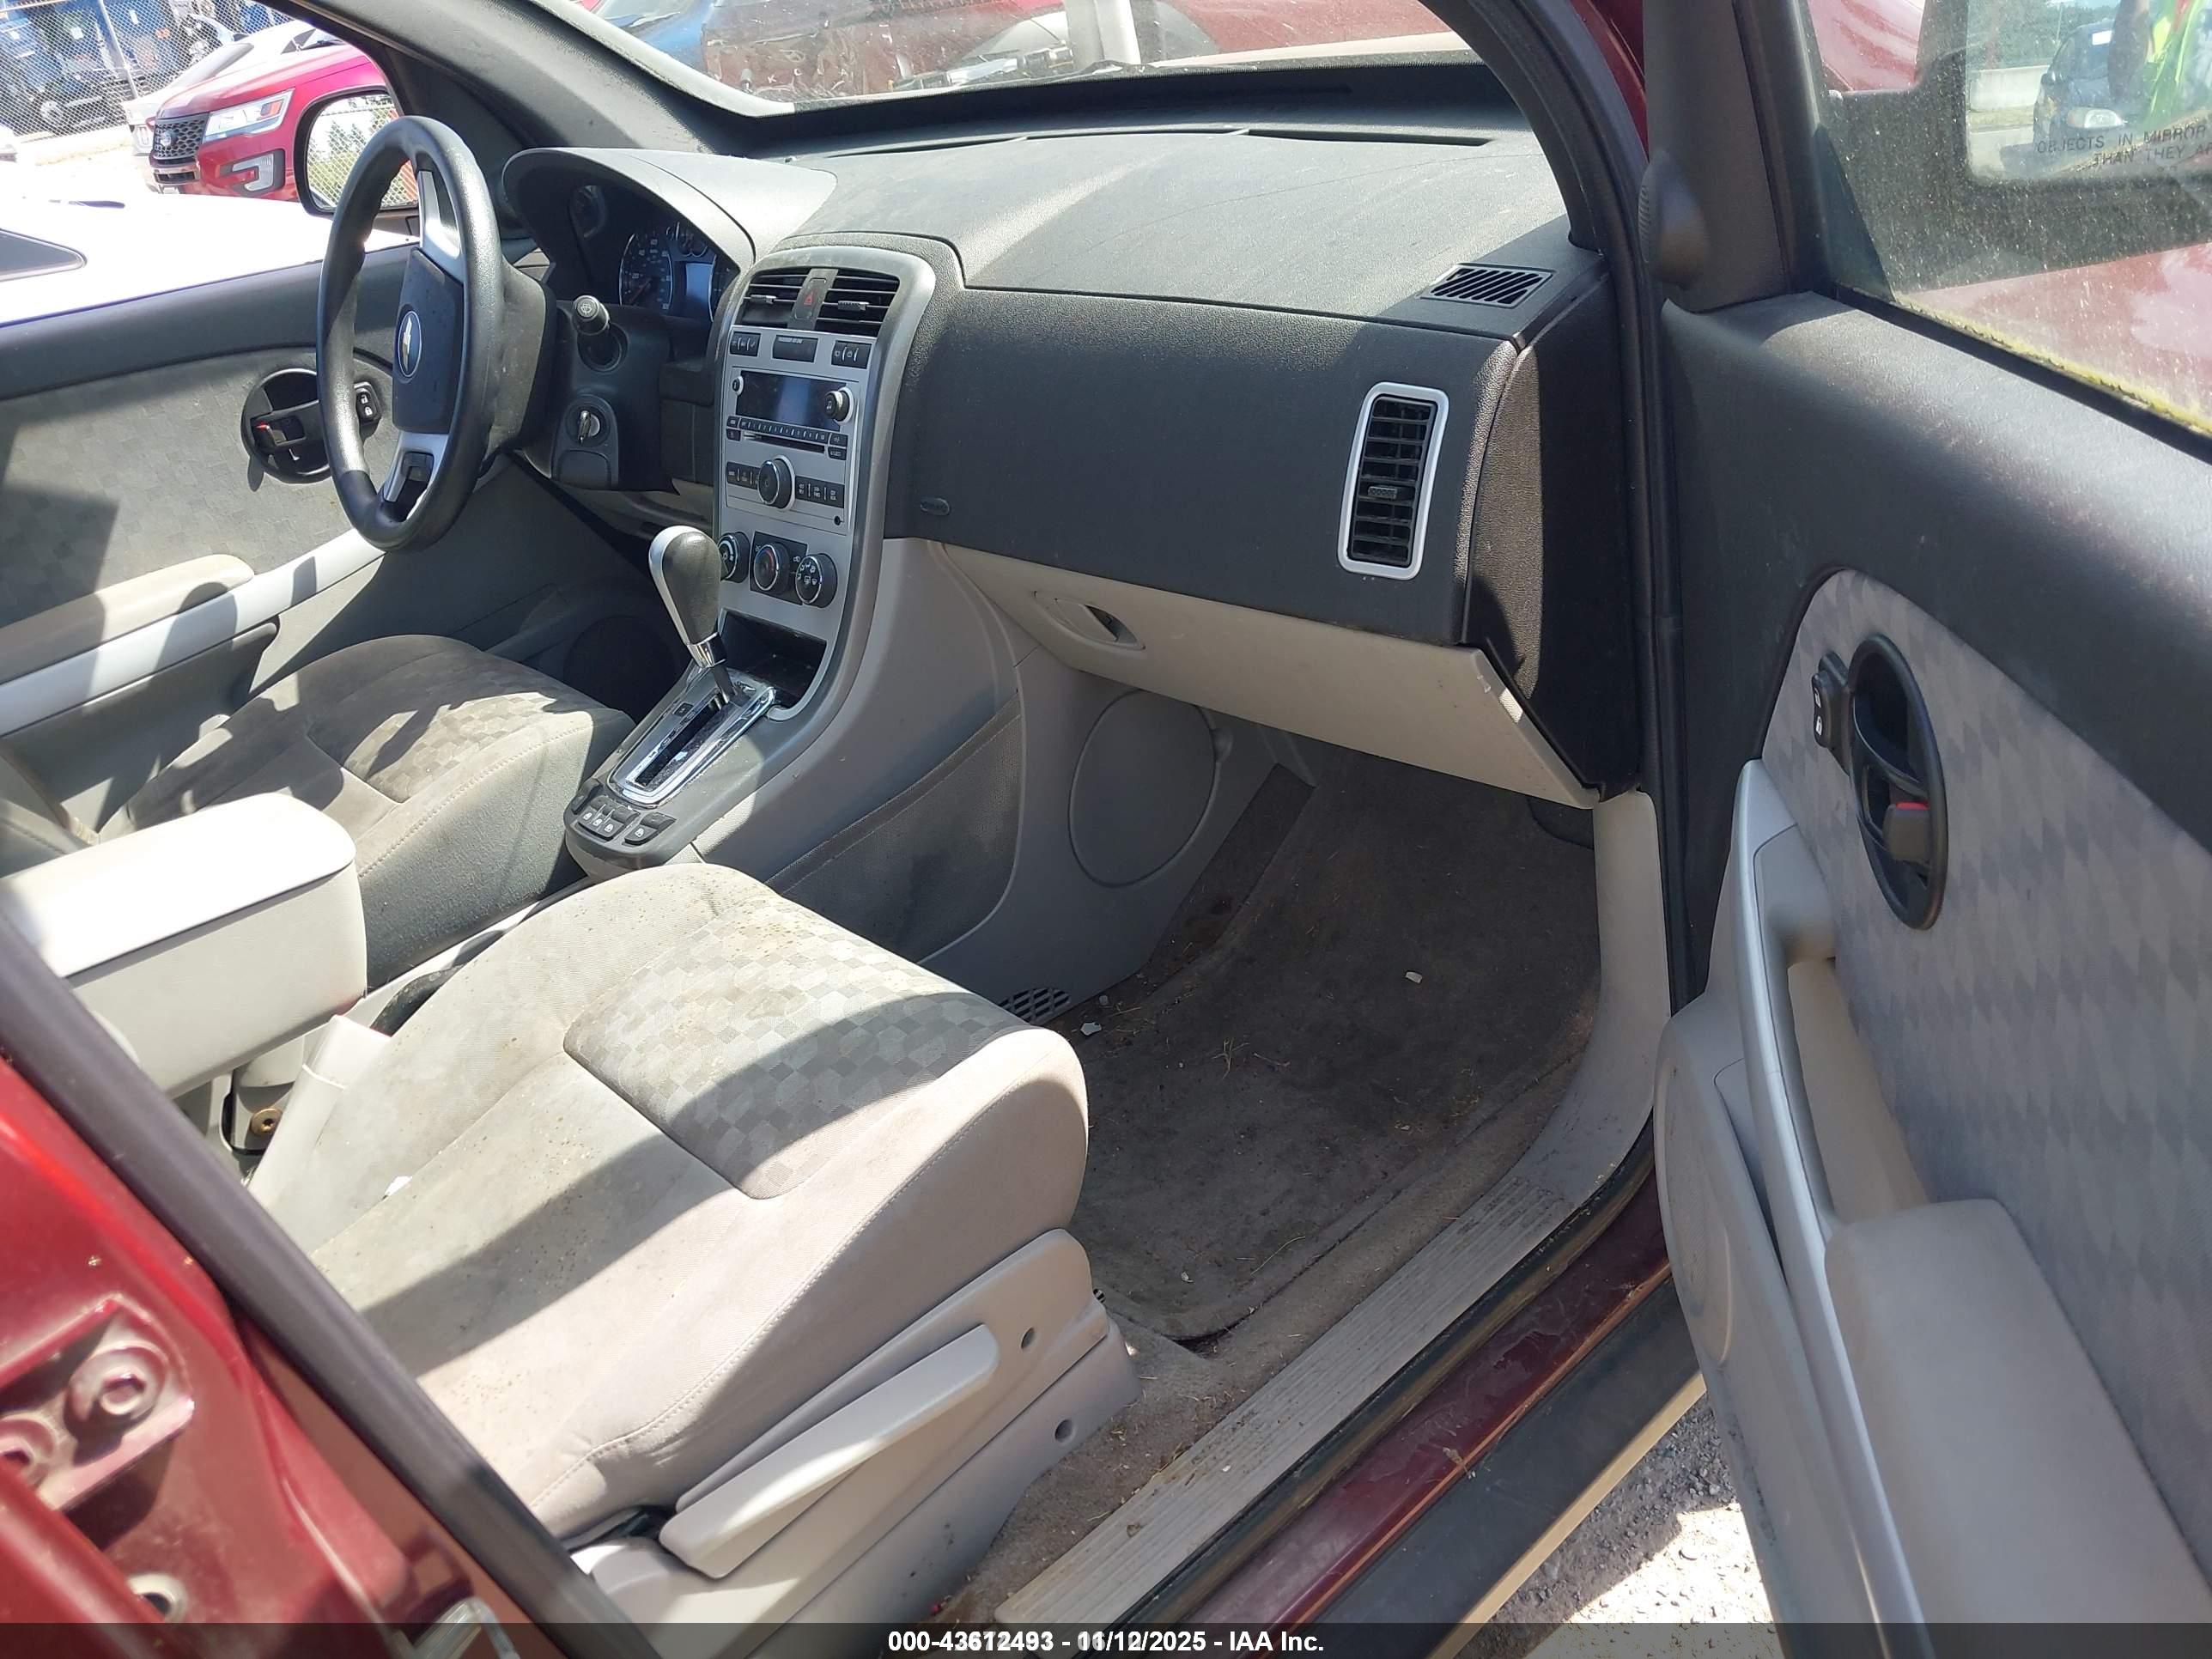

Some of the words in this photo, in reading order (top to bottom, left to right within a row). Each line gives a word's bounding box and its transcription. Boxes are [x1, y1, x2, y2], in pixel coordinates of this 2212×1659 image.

[2038, 136, 2104, 153] OBJECTS
[2118, 133, 2133, 146] IN
[2143, 125, 2206, 143] MIRROR
[2094, 148, 2135, 165] THAN
[2145, 145, 2186, 161] THEY
